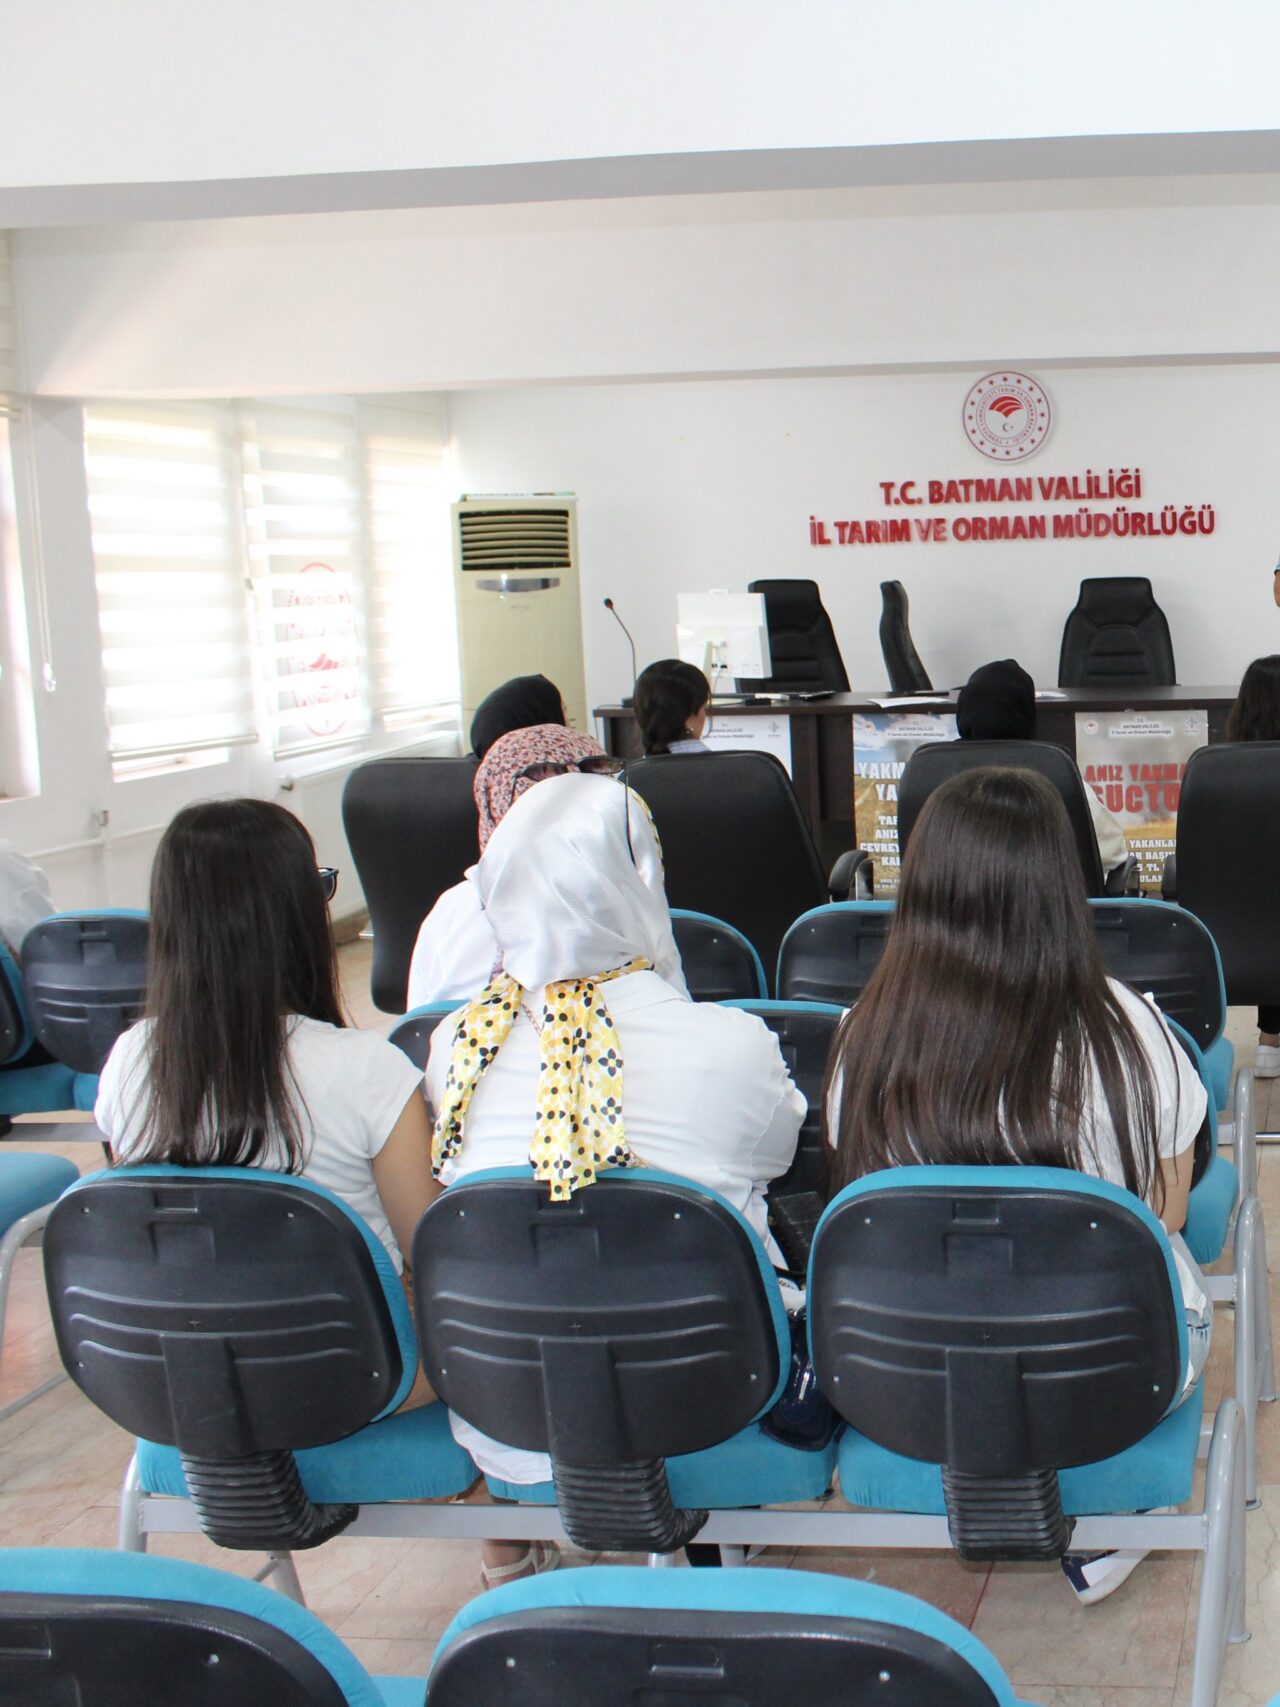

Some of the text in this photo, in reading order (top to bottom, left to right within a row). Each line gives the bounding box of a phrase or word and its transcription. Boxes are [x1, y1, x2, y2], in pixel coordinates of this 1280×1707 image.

[880, 468, 1141, 505] T.C. BATMAN VALİLİĞİ
[810, 504, 1214, 545] İL TARIM VE ORMAN MÜDÜRLÜĞÜ
